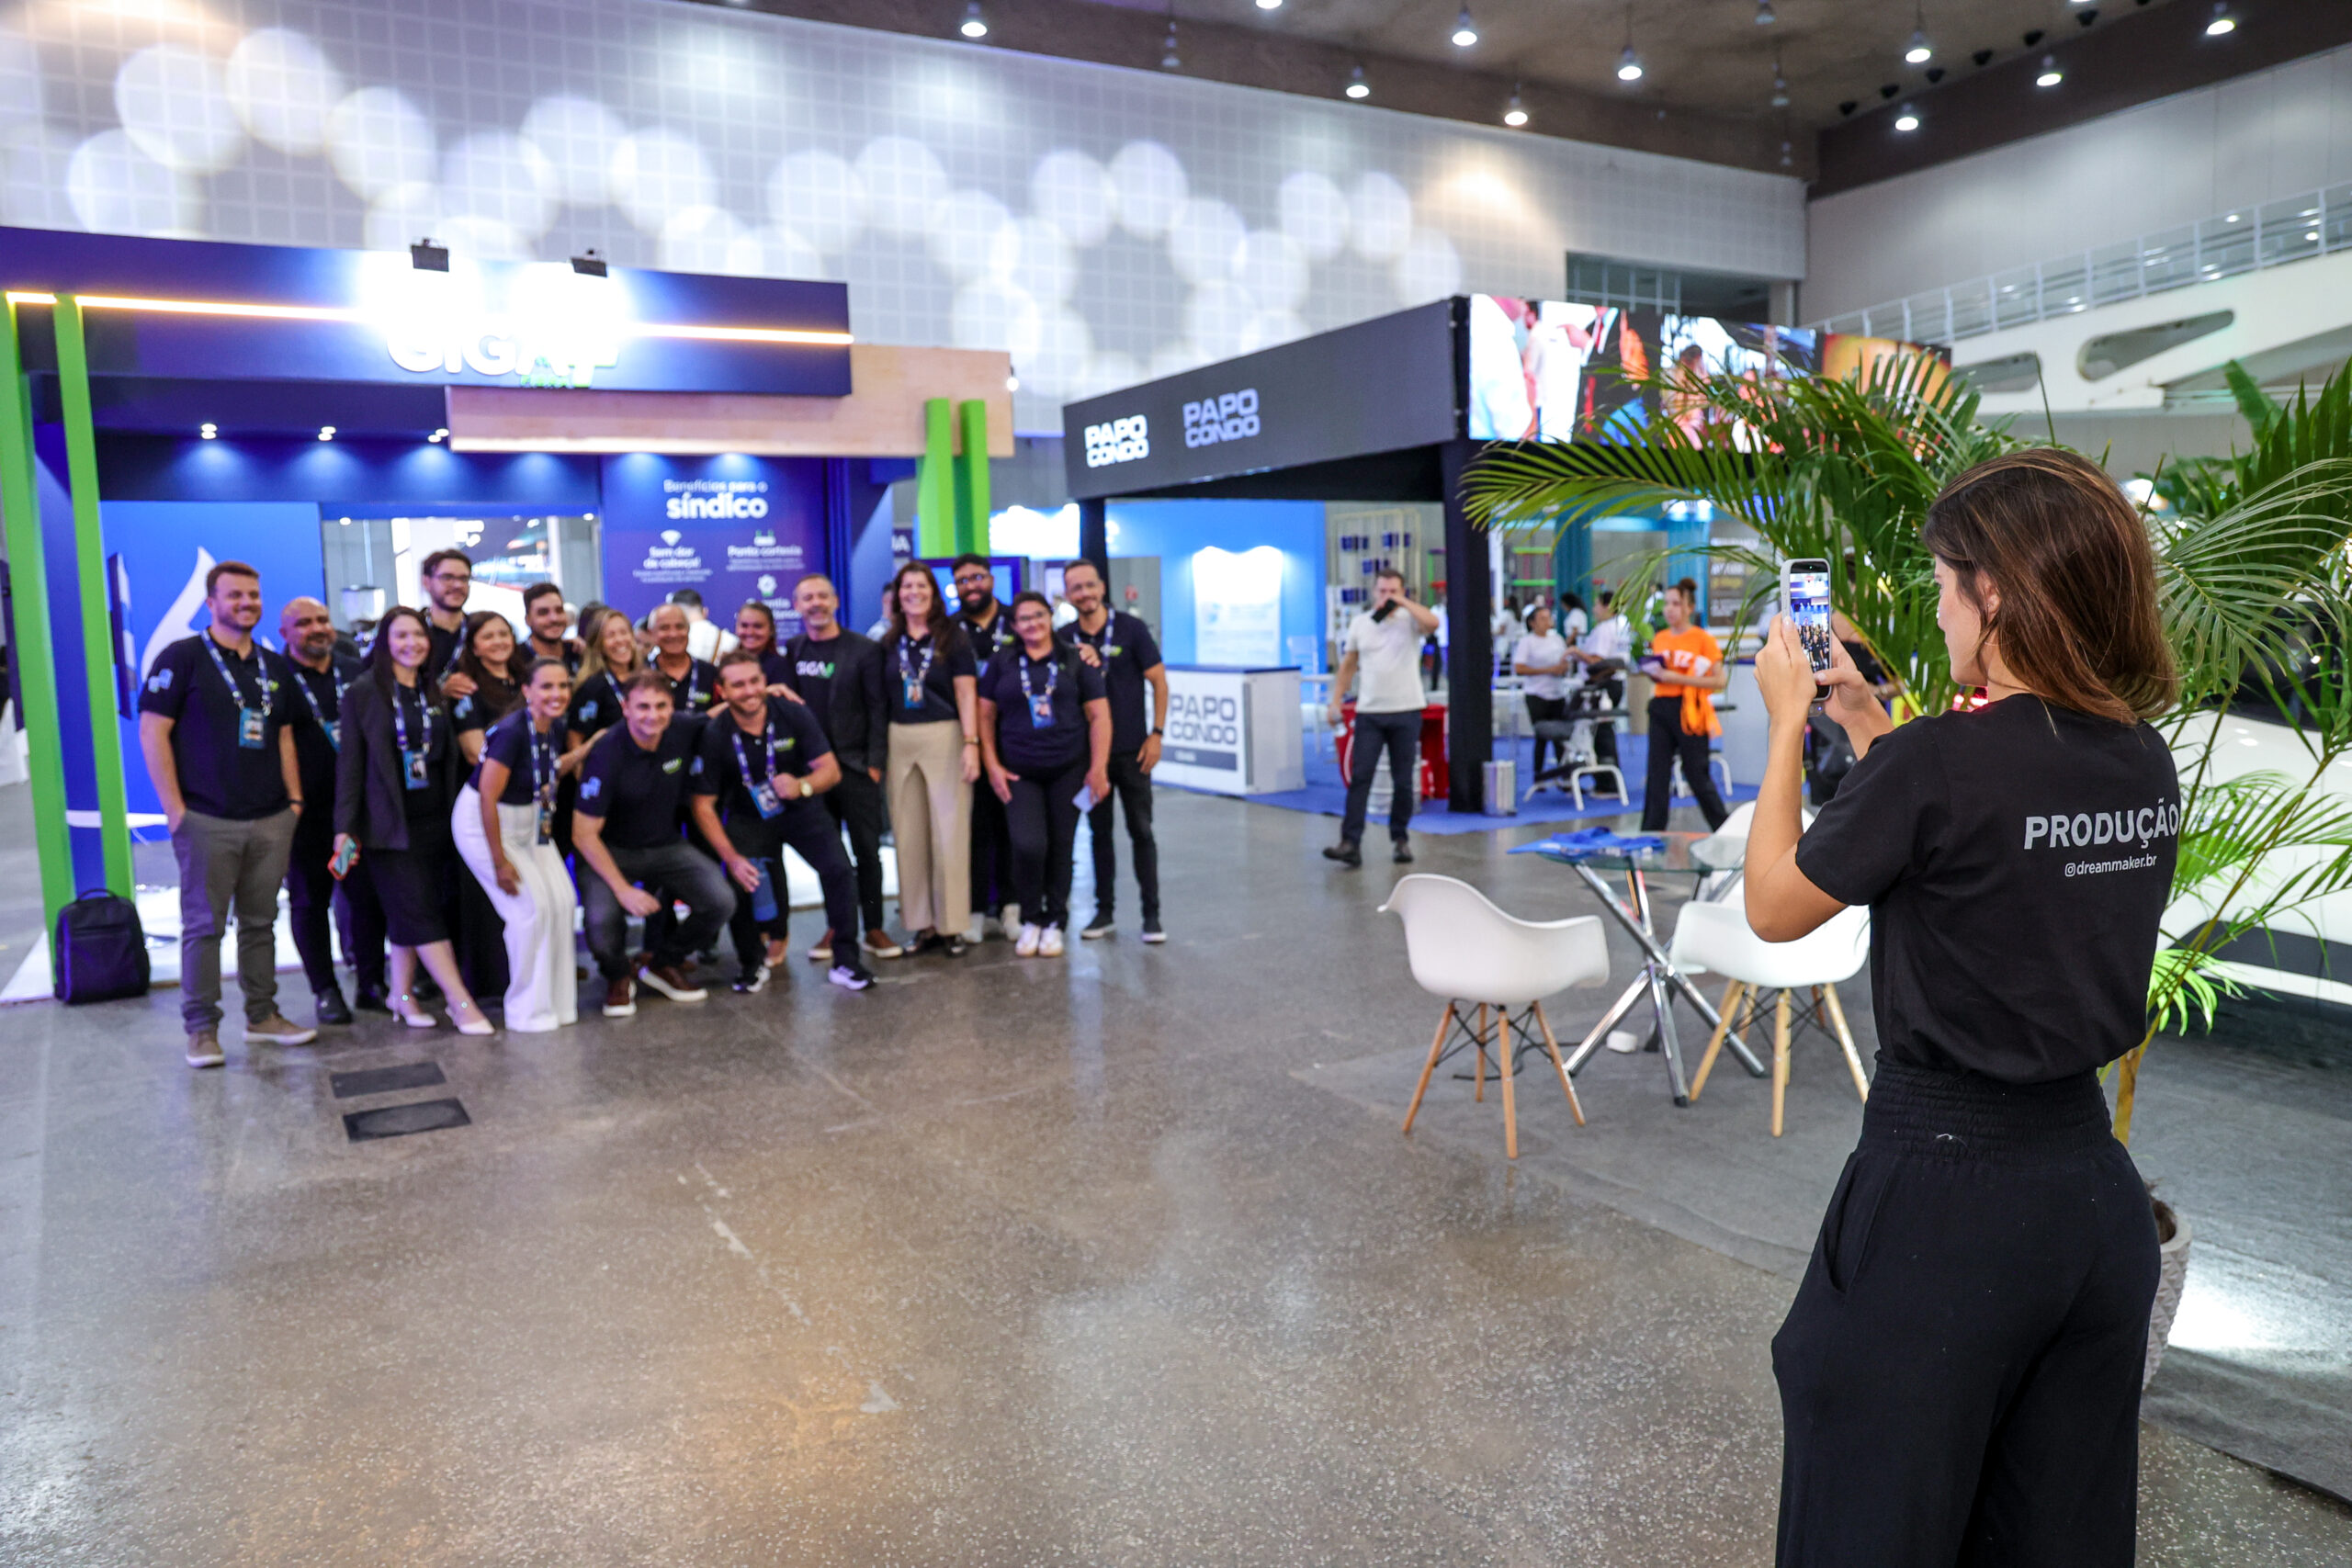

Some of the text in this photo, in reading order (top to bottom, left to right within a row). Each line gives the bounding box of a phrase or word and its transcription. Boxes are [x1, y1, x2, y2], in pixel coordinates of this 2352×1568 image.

[1182, 388, 1260, 428] PAPO
[1084, 414, 1148, 450] PAPO
[1184, 414, 1261, 448] CONDO
[1086, 438, 1149, 468] CONDO
[666, 491, 769, 519] síndico
[1170, 694, 1237, 722] PAPO
[1170, 721, 1238, 745] CONDO
[2023, 796, 2179, 850] PRODUÇÃO
